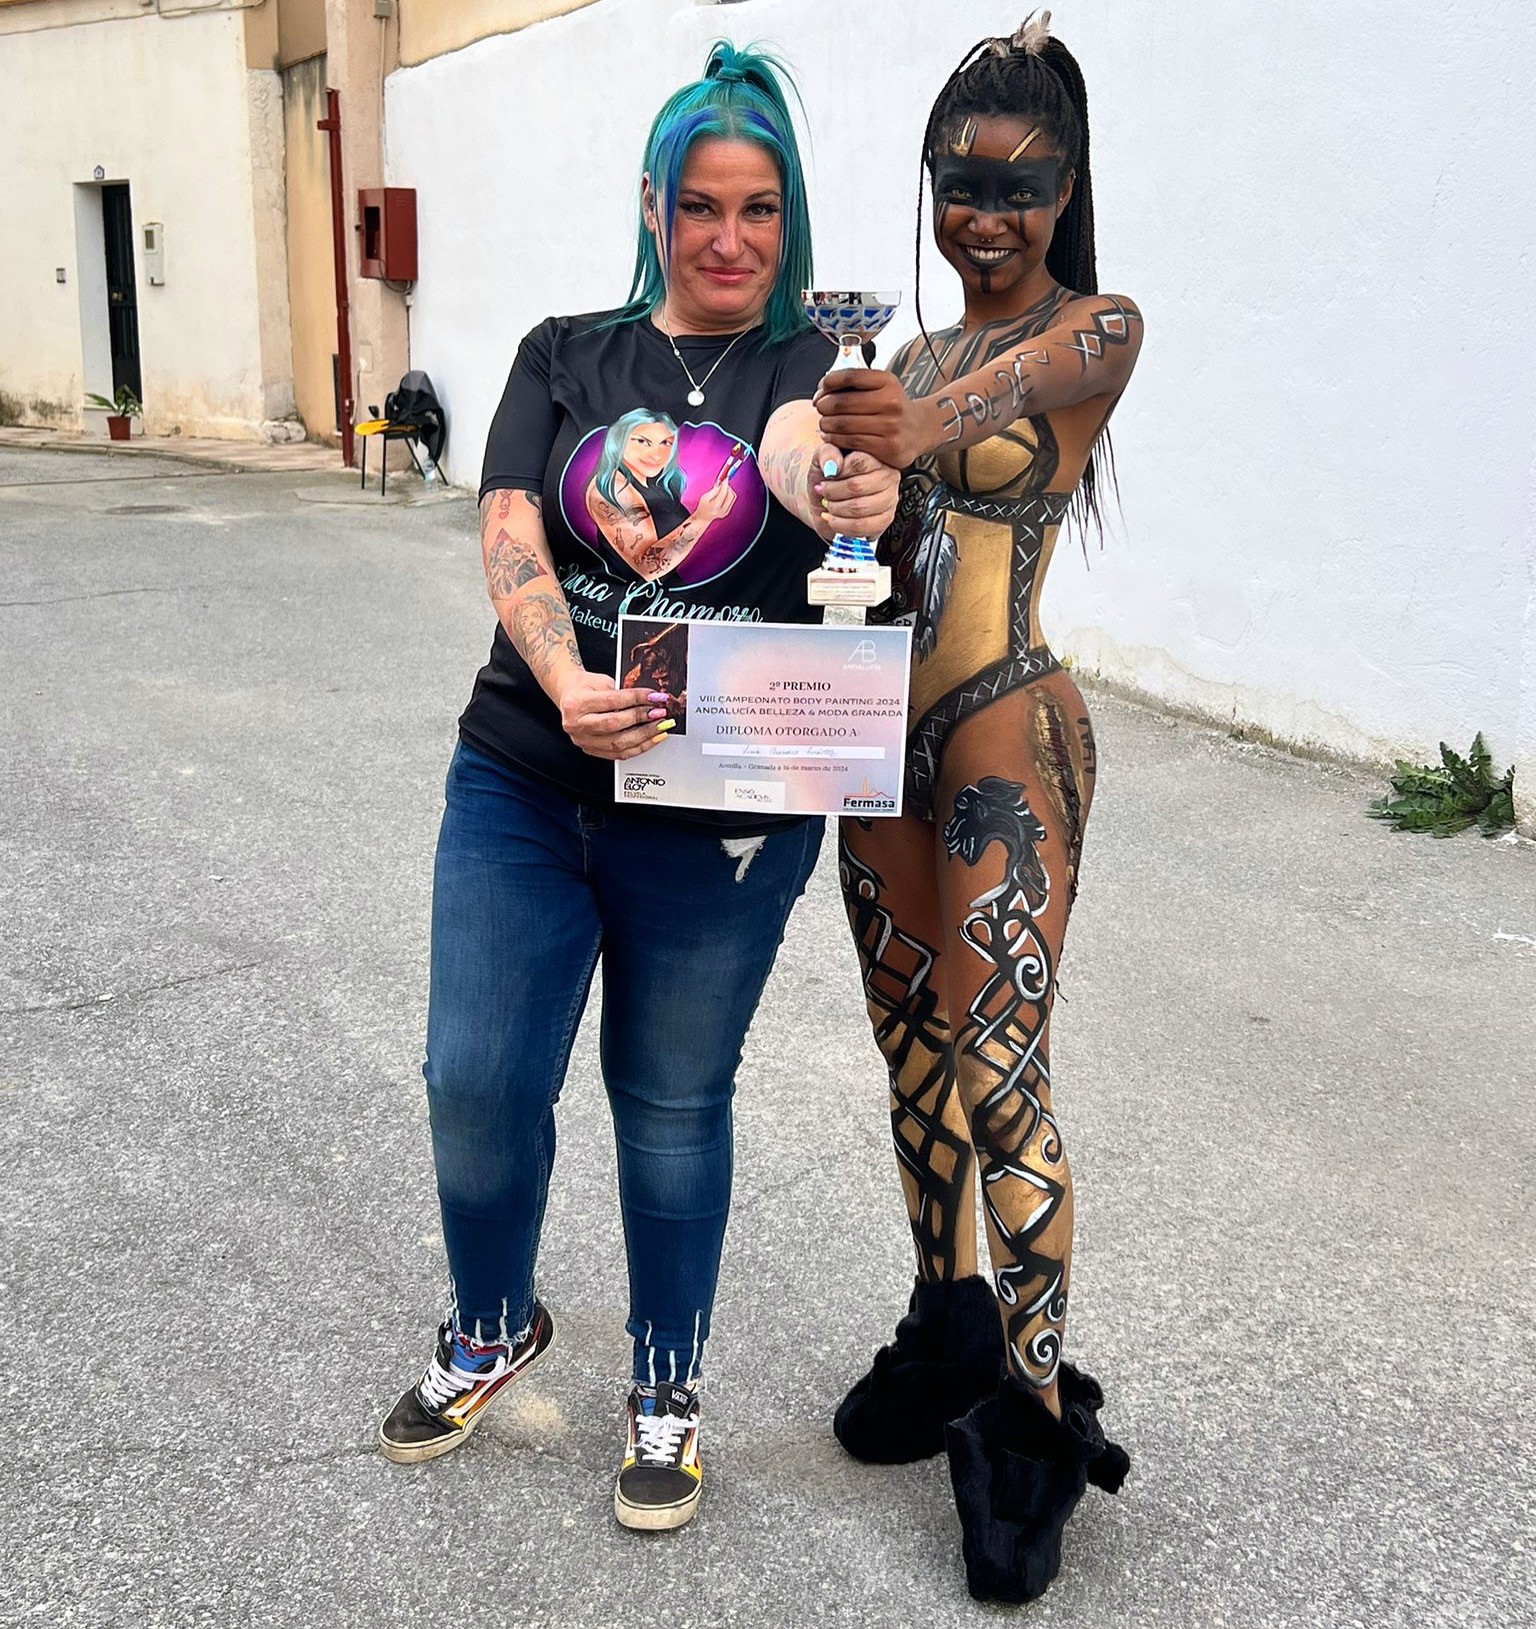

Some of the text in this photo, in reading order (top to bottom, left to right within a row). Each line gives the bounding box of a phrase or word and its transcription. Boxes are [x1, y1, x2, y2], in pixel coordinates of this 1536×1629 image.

[783, 681, 831, 691] PREMIO
[699, 695, 716, 703] VIII
[718, 695, 791, 705] CAMPEONATO
[793, 697, 822, 706] BODY
[825, 698, 874, 706] PAINTING
[695, 706, 756, 715] ANDALUCÍA
[759, 708, 806, 716] BELLEZA
[818, 709, 849, 717] MODA
[851, 709, 903, 717] GRANADA
[716, 725, 773, 736] DIPLOMA
[775, 726, 847, 737] OTORGADO
[843, 797, 895, 808] Fermasa
[671, 1389, 689, 1405] VANS
